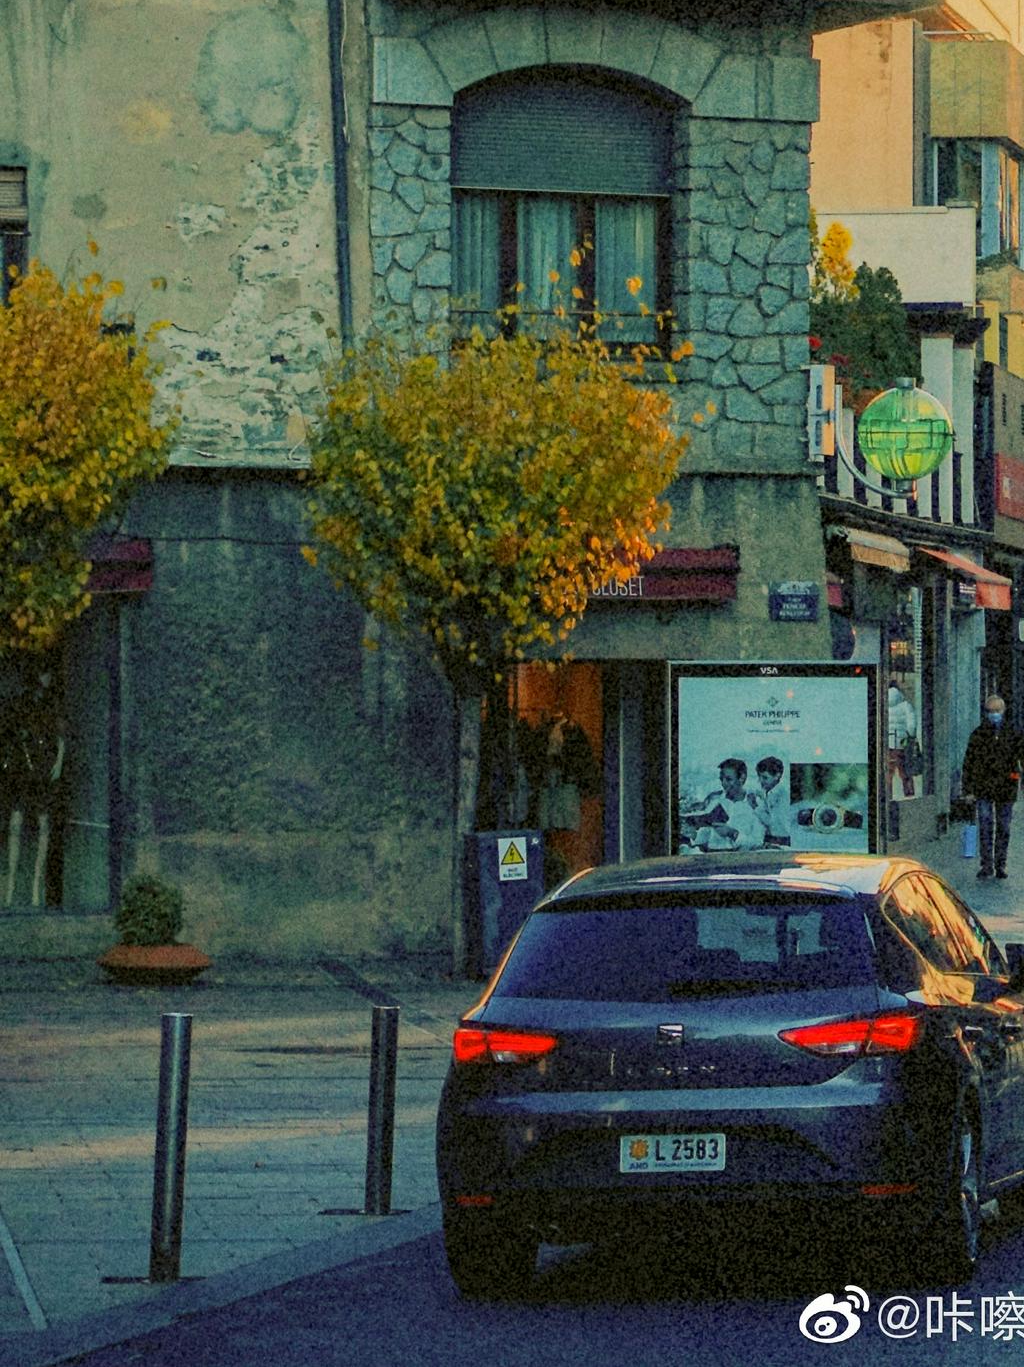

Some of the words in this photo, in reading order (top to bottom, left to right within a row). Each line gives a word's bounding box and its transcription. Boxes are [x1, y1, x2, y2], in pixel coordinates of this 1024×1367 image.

[745, 710, 767, 718] PATEK
[655, 1139, 666, 1161] L
[671, 1138, 719, 1160] 2583
[629, 1162, 648, 1170] AND
